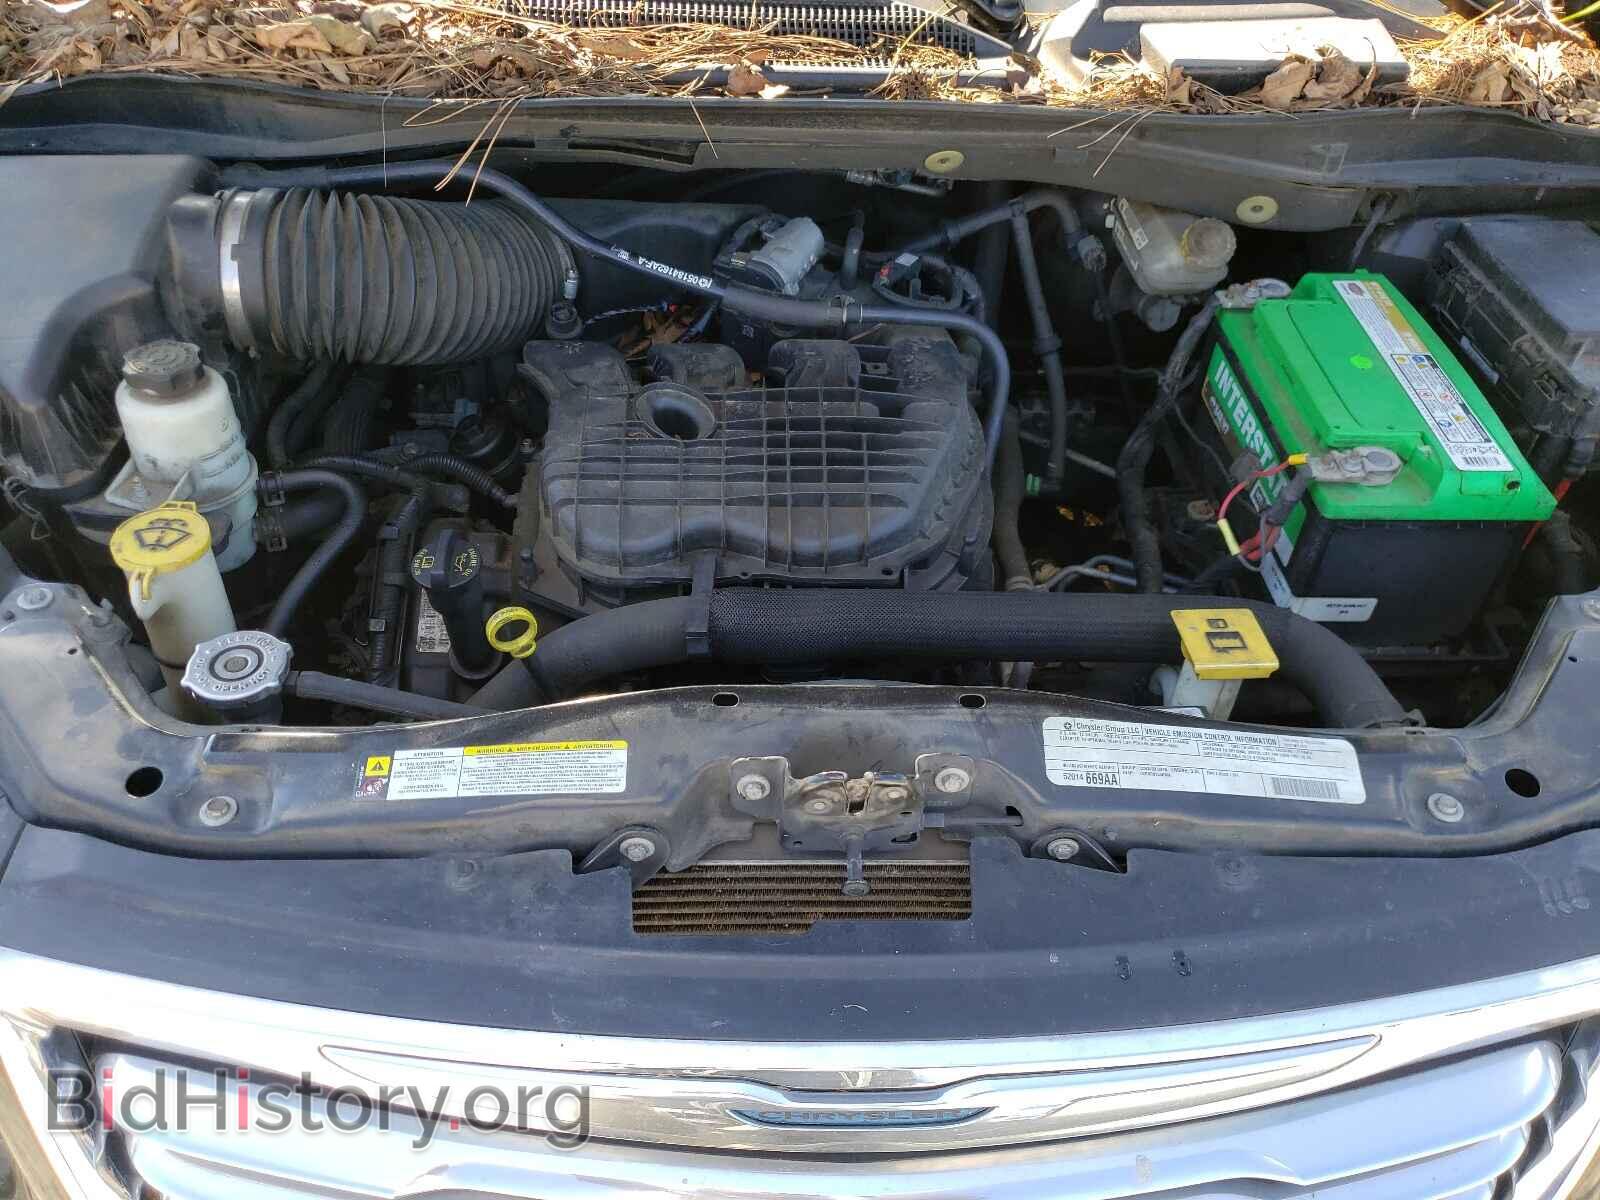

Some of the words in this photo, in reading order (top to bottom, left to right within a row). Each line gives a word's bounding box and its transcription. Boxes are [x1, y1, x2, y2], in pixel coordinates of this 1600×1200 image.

[1214, 360, 1289, 499] INTERSTT
[1076, 722, 1103, 732] Chrysler
[1144, 728, 1171, 736] VEHICLE
[1173, 730, 1203, 739] EMISSION
[1204, 733, 1232, 741] CONTROL
[1234, 735, 1277, 745] INFORMATION
[1085, 773, 1118, 786] 669AA
